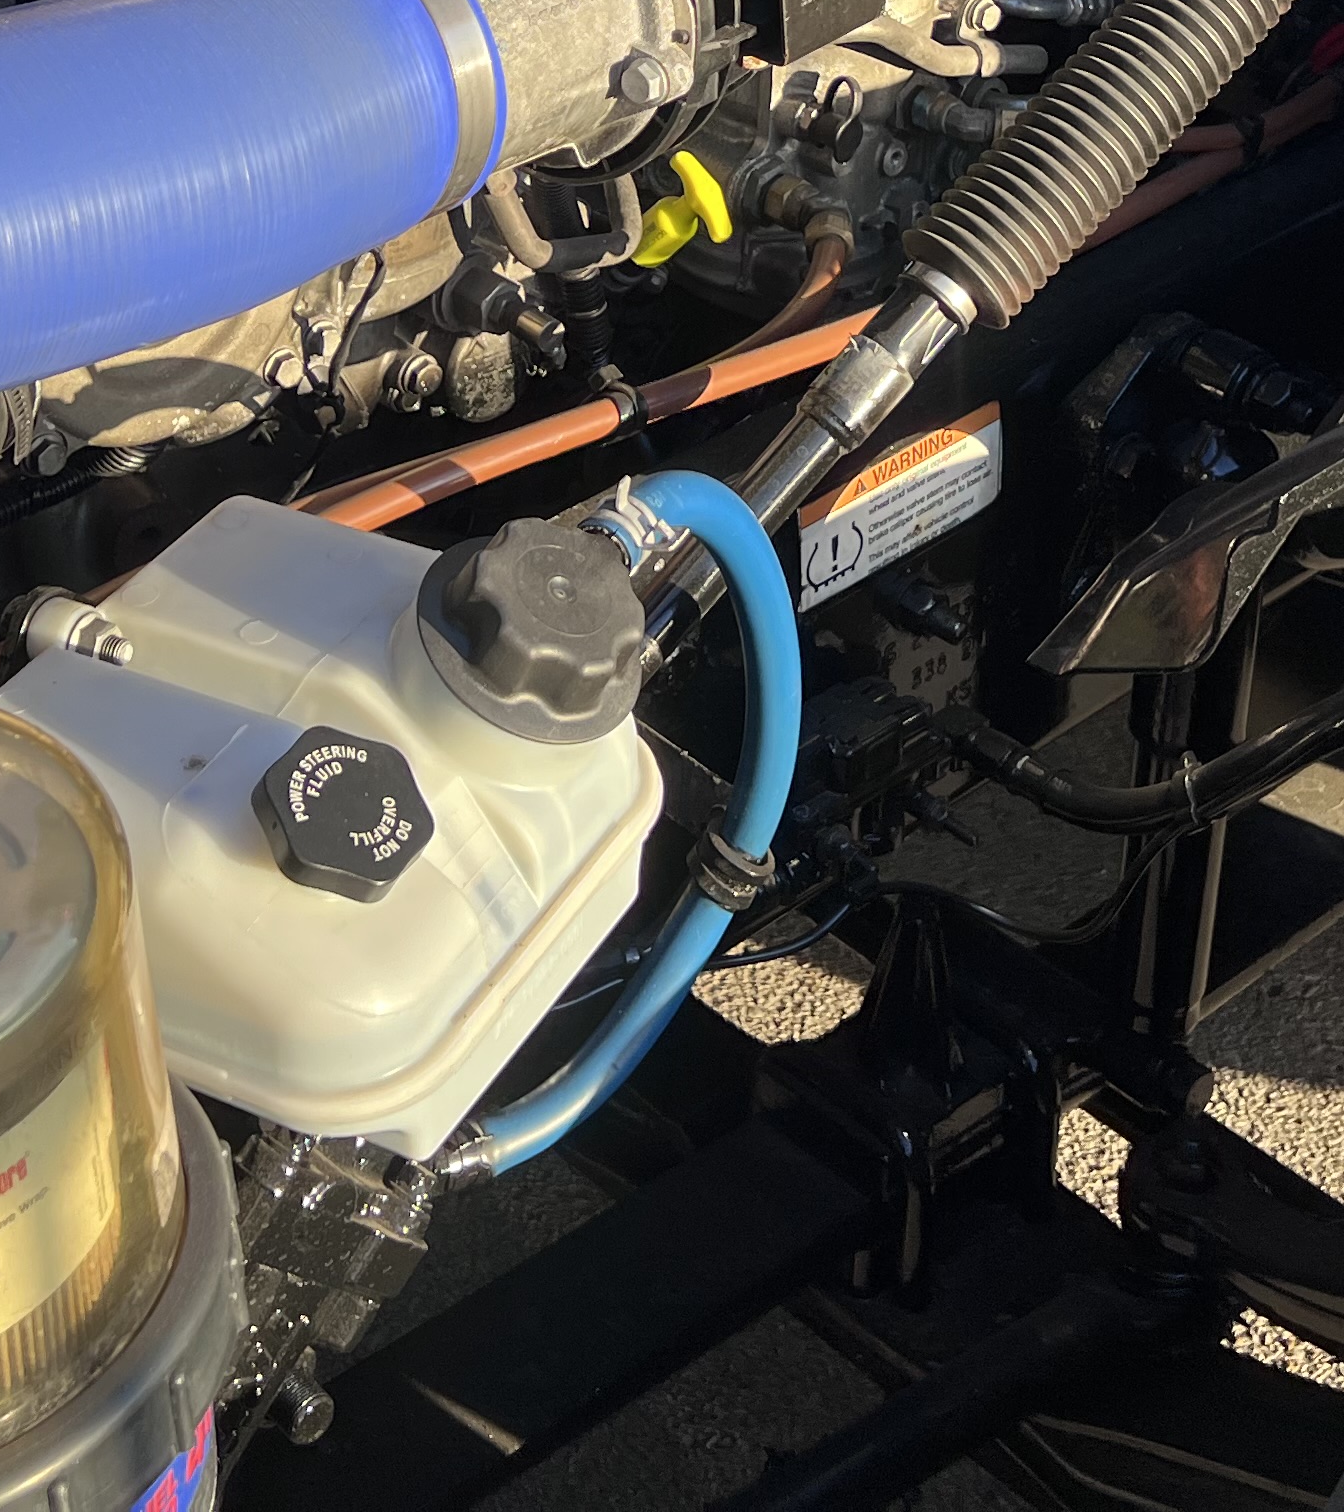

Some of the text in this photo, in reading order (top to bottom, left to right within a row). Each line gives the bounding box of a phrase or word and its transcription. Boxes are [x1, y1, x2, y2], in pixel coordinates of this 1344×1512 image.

[873, 429, 954, 486] WARNING
[867, 497, 891, 516] wheel
[889, 488, 907, 503] and
[905, 477, 926, 494] valve
[867, 460, 988, 534] Otherwise valve stem may contact
[867, 528, 890, 545] brake
[888, 514, 916, 534] caliper
[914, 496, 944, 518] causing
[867, 549, 884, 564] This
[883, 540, 901, 554] may
[948, 496, 975, 517] control
[288, 744, 368, 823] POWER STEERING
[306, 761, 343, 798] FLUID
[349, 796, 396, 846] OVERFILL
[372, 819, 413, 862] DO NOT
